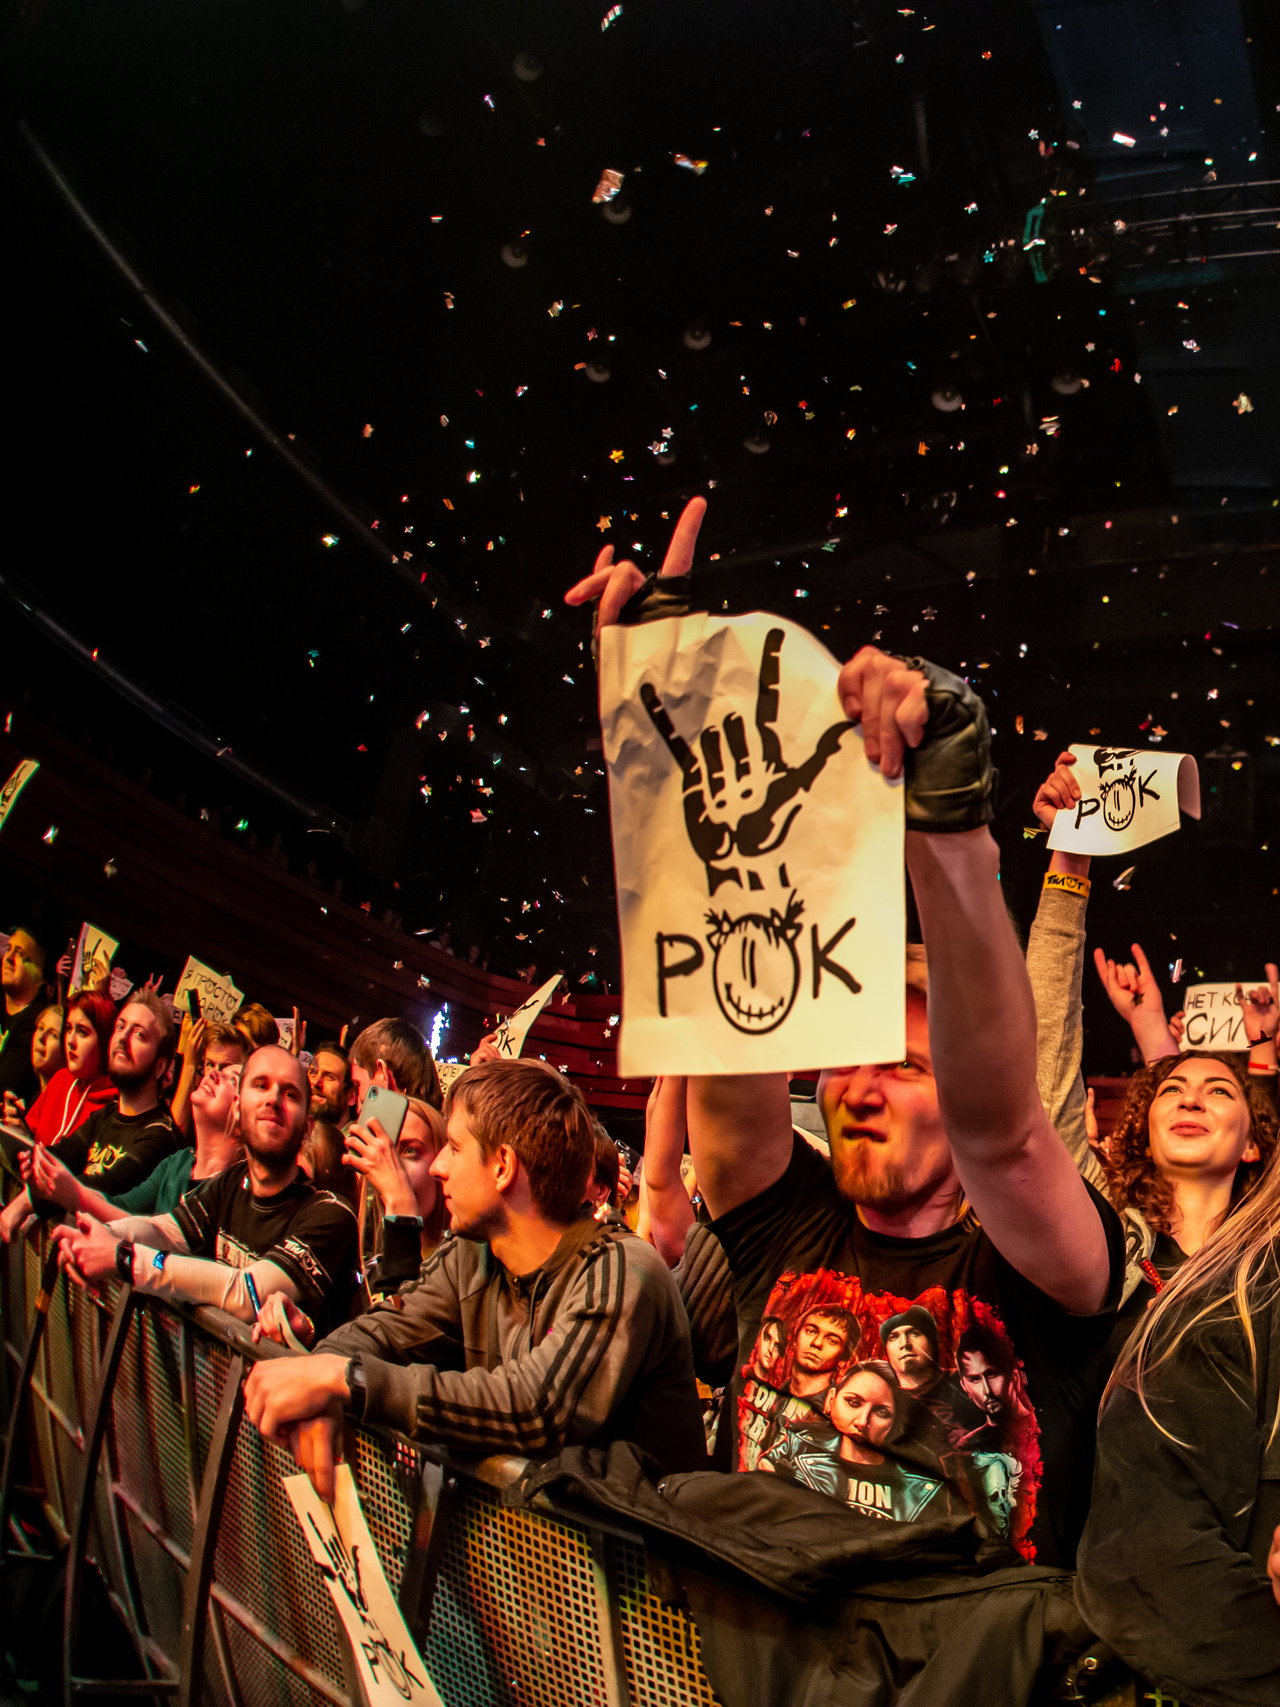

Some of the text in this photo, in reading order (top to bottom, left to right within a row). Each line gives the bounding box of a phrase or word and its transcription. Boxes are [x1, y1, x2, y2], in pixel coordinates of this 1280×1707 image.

[184, 969, 239, 1012] Я ПРОСТО
[1186, 991, 1219, 1010] НЕТ
